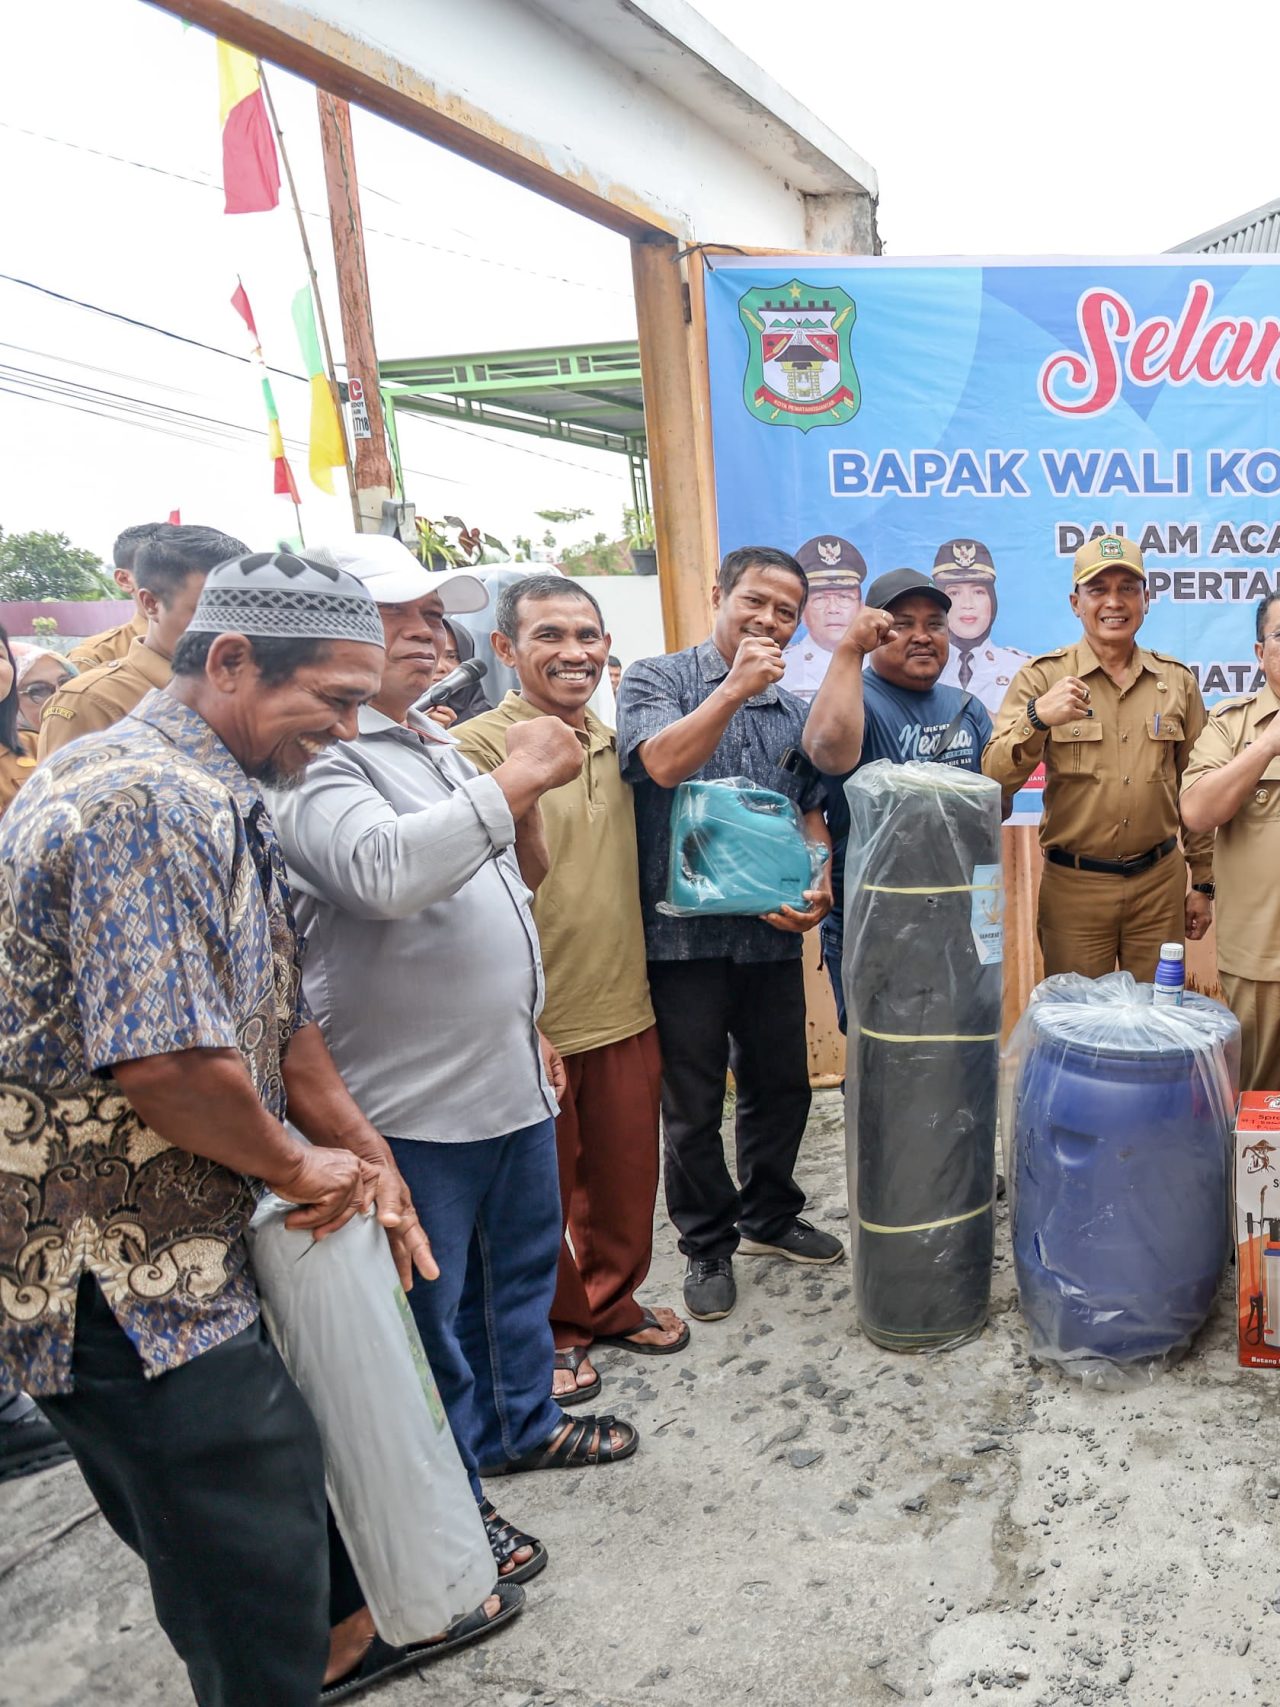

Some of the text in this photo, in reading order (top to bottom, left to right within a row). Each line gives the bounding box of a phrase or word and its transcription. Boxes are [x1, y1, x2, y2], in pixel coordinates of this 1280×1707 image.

[831, 450, 1027, 496] BAPAK
[1042, 450, 1190, 496] WALI
[1251, 1356, 1278, 1365] Batang
